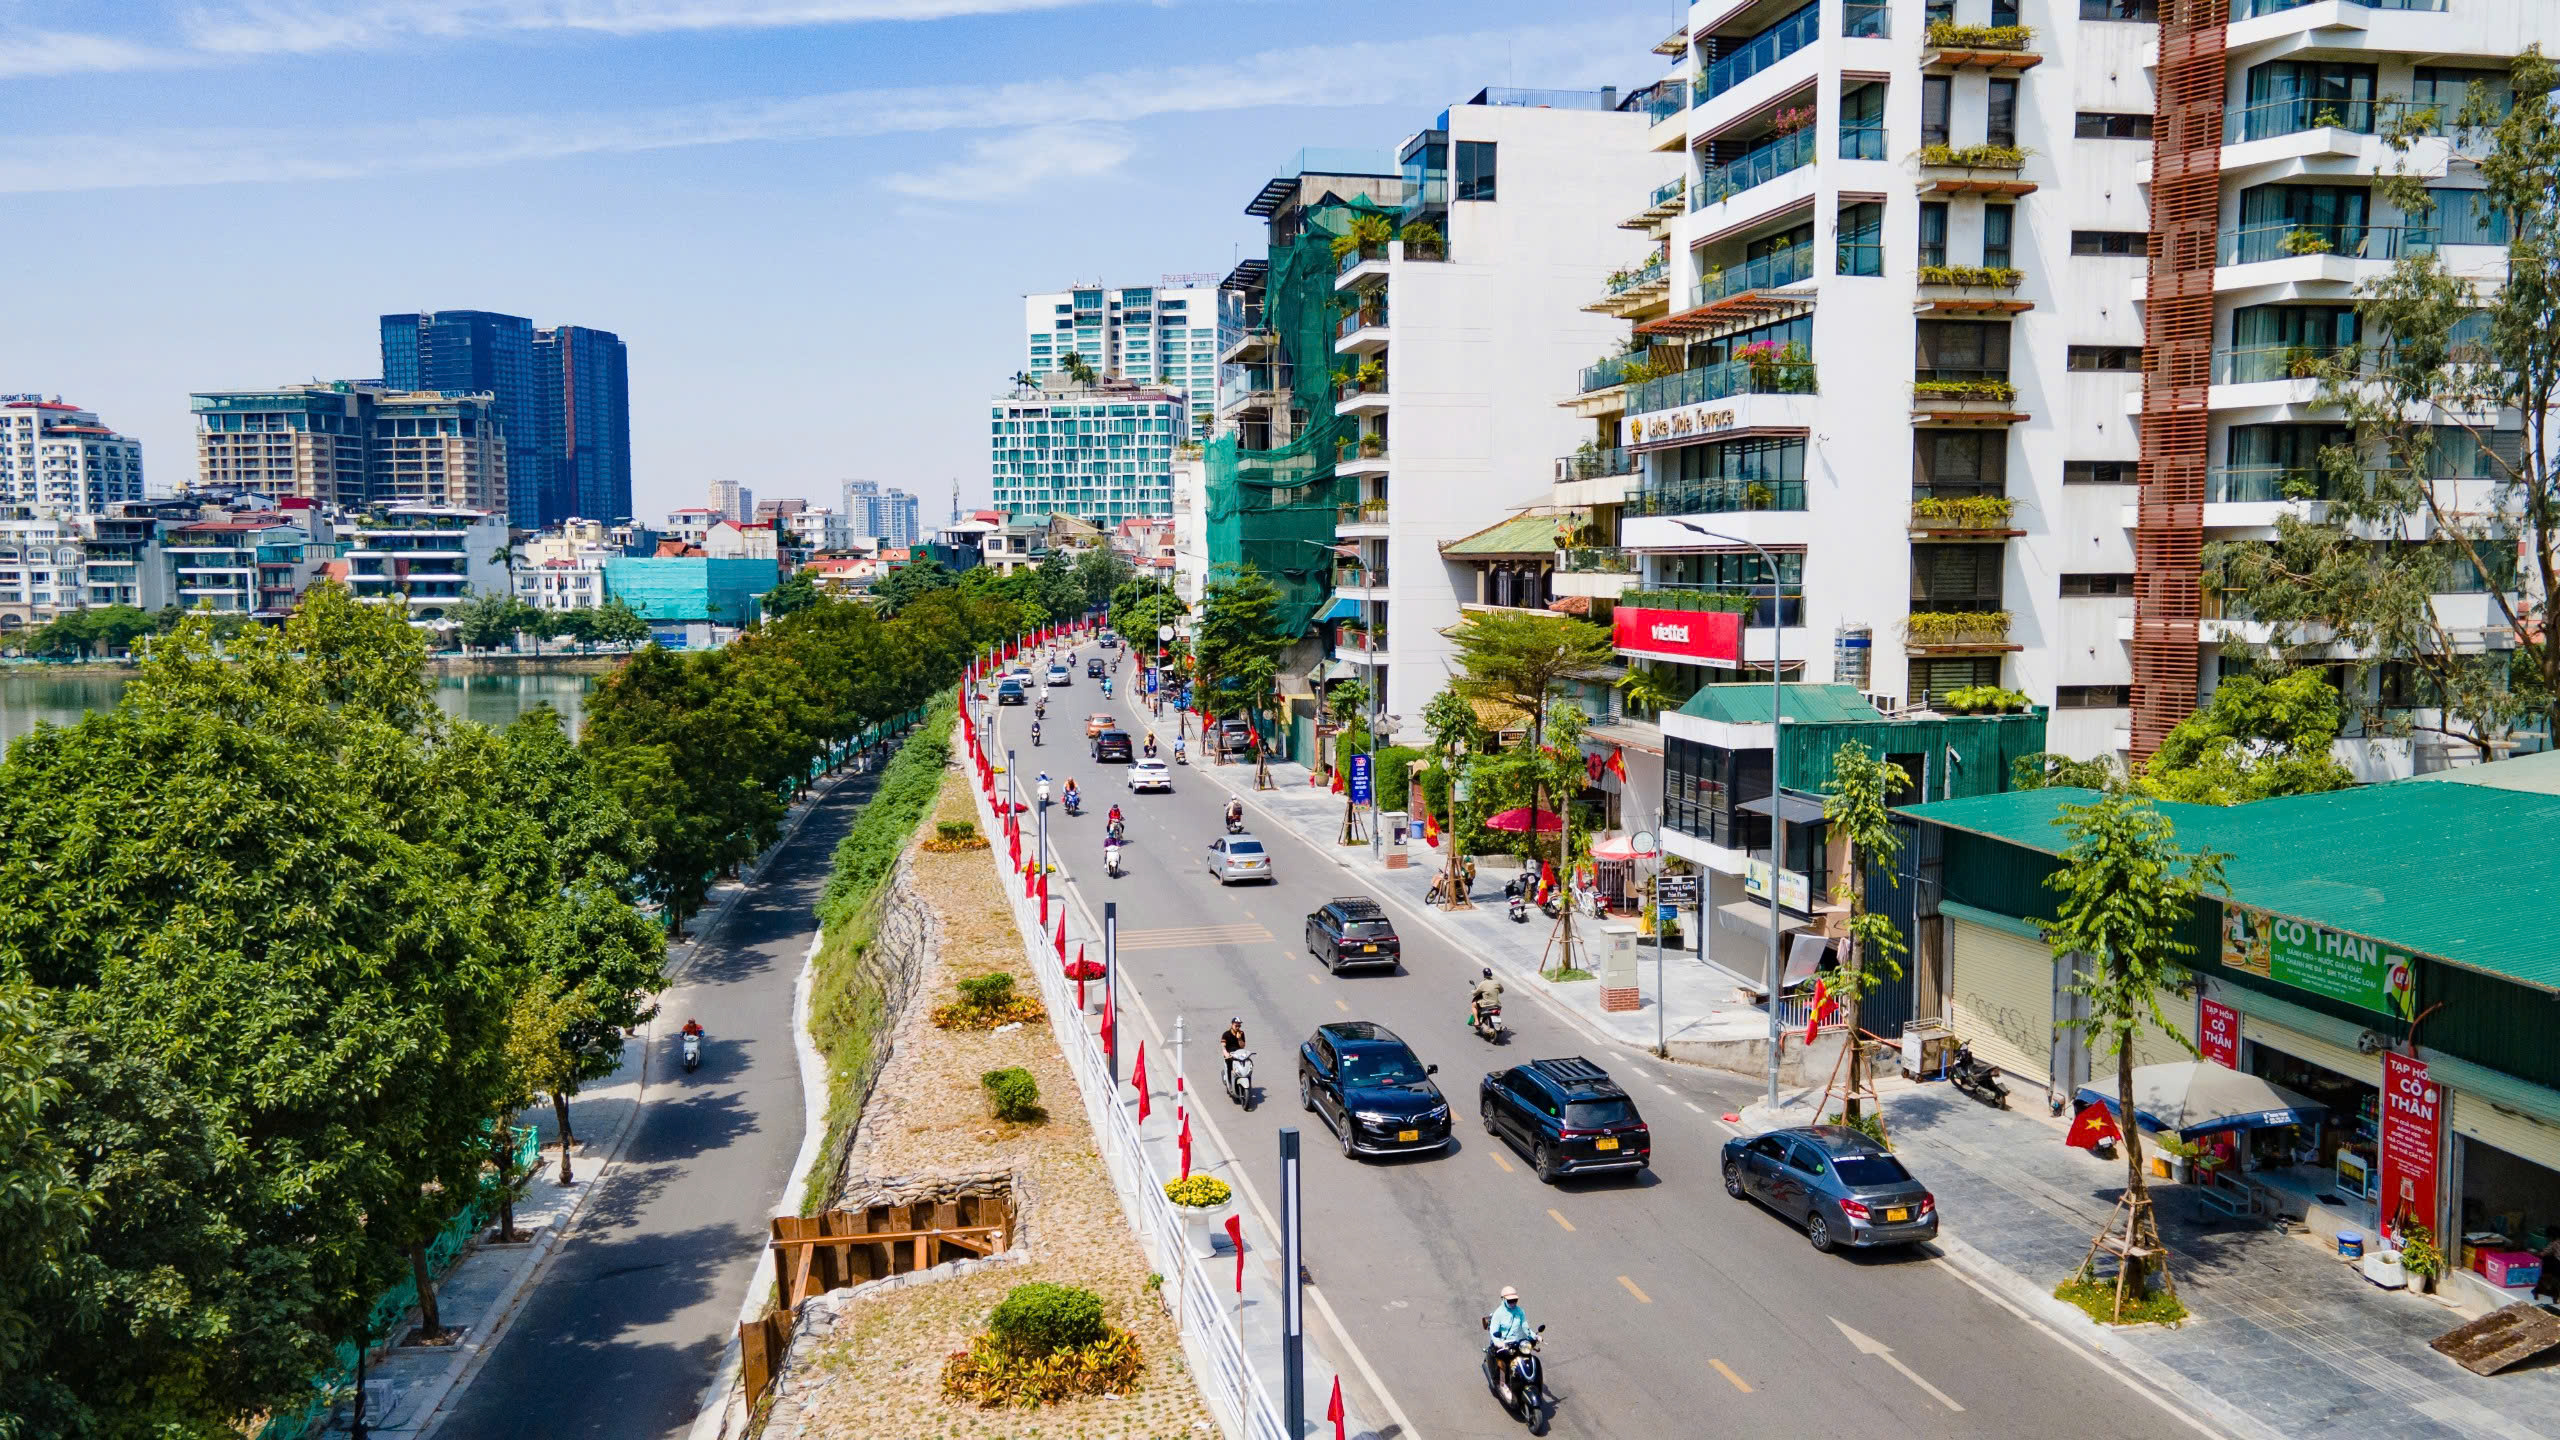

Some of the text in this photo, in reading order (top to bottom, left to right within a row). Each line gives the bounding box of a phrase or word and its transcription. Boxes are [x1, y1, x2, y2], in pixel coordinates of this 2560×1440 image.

[1648, 408, 1735, 437] Lake Side Terrace
[1651, 622, 1689, 643] viettel
[2206, 1005, 2234, 1021] TẠP HÓA
[2211, 1019, 2226, 1032] CÔ
[2205, 1030, 2232, 1050] THÂN
[2390, 1059, 2431, 1082] TẠP HÓ
[2400, 1079, 2423, 1097] CÔ
[2388, 1092, 2433, 1121] THÂN
